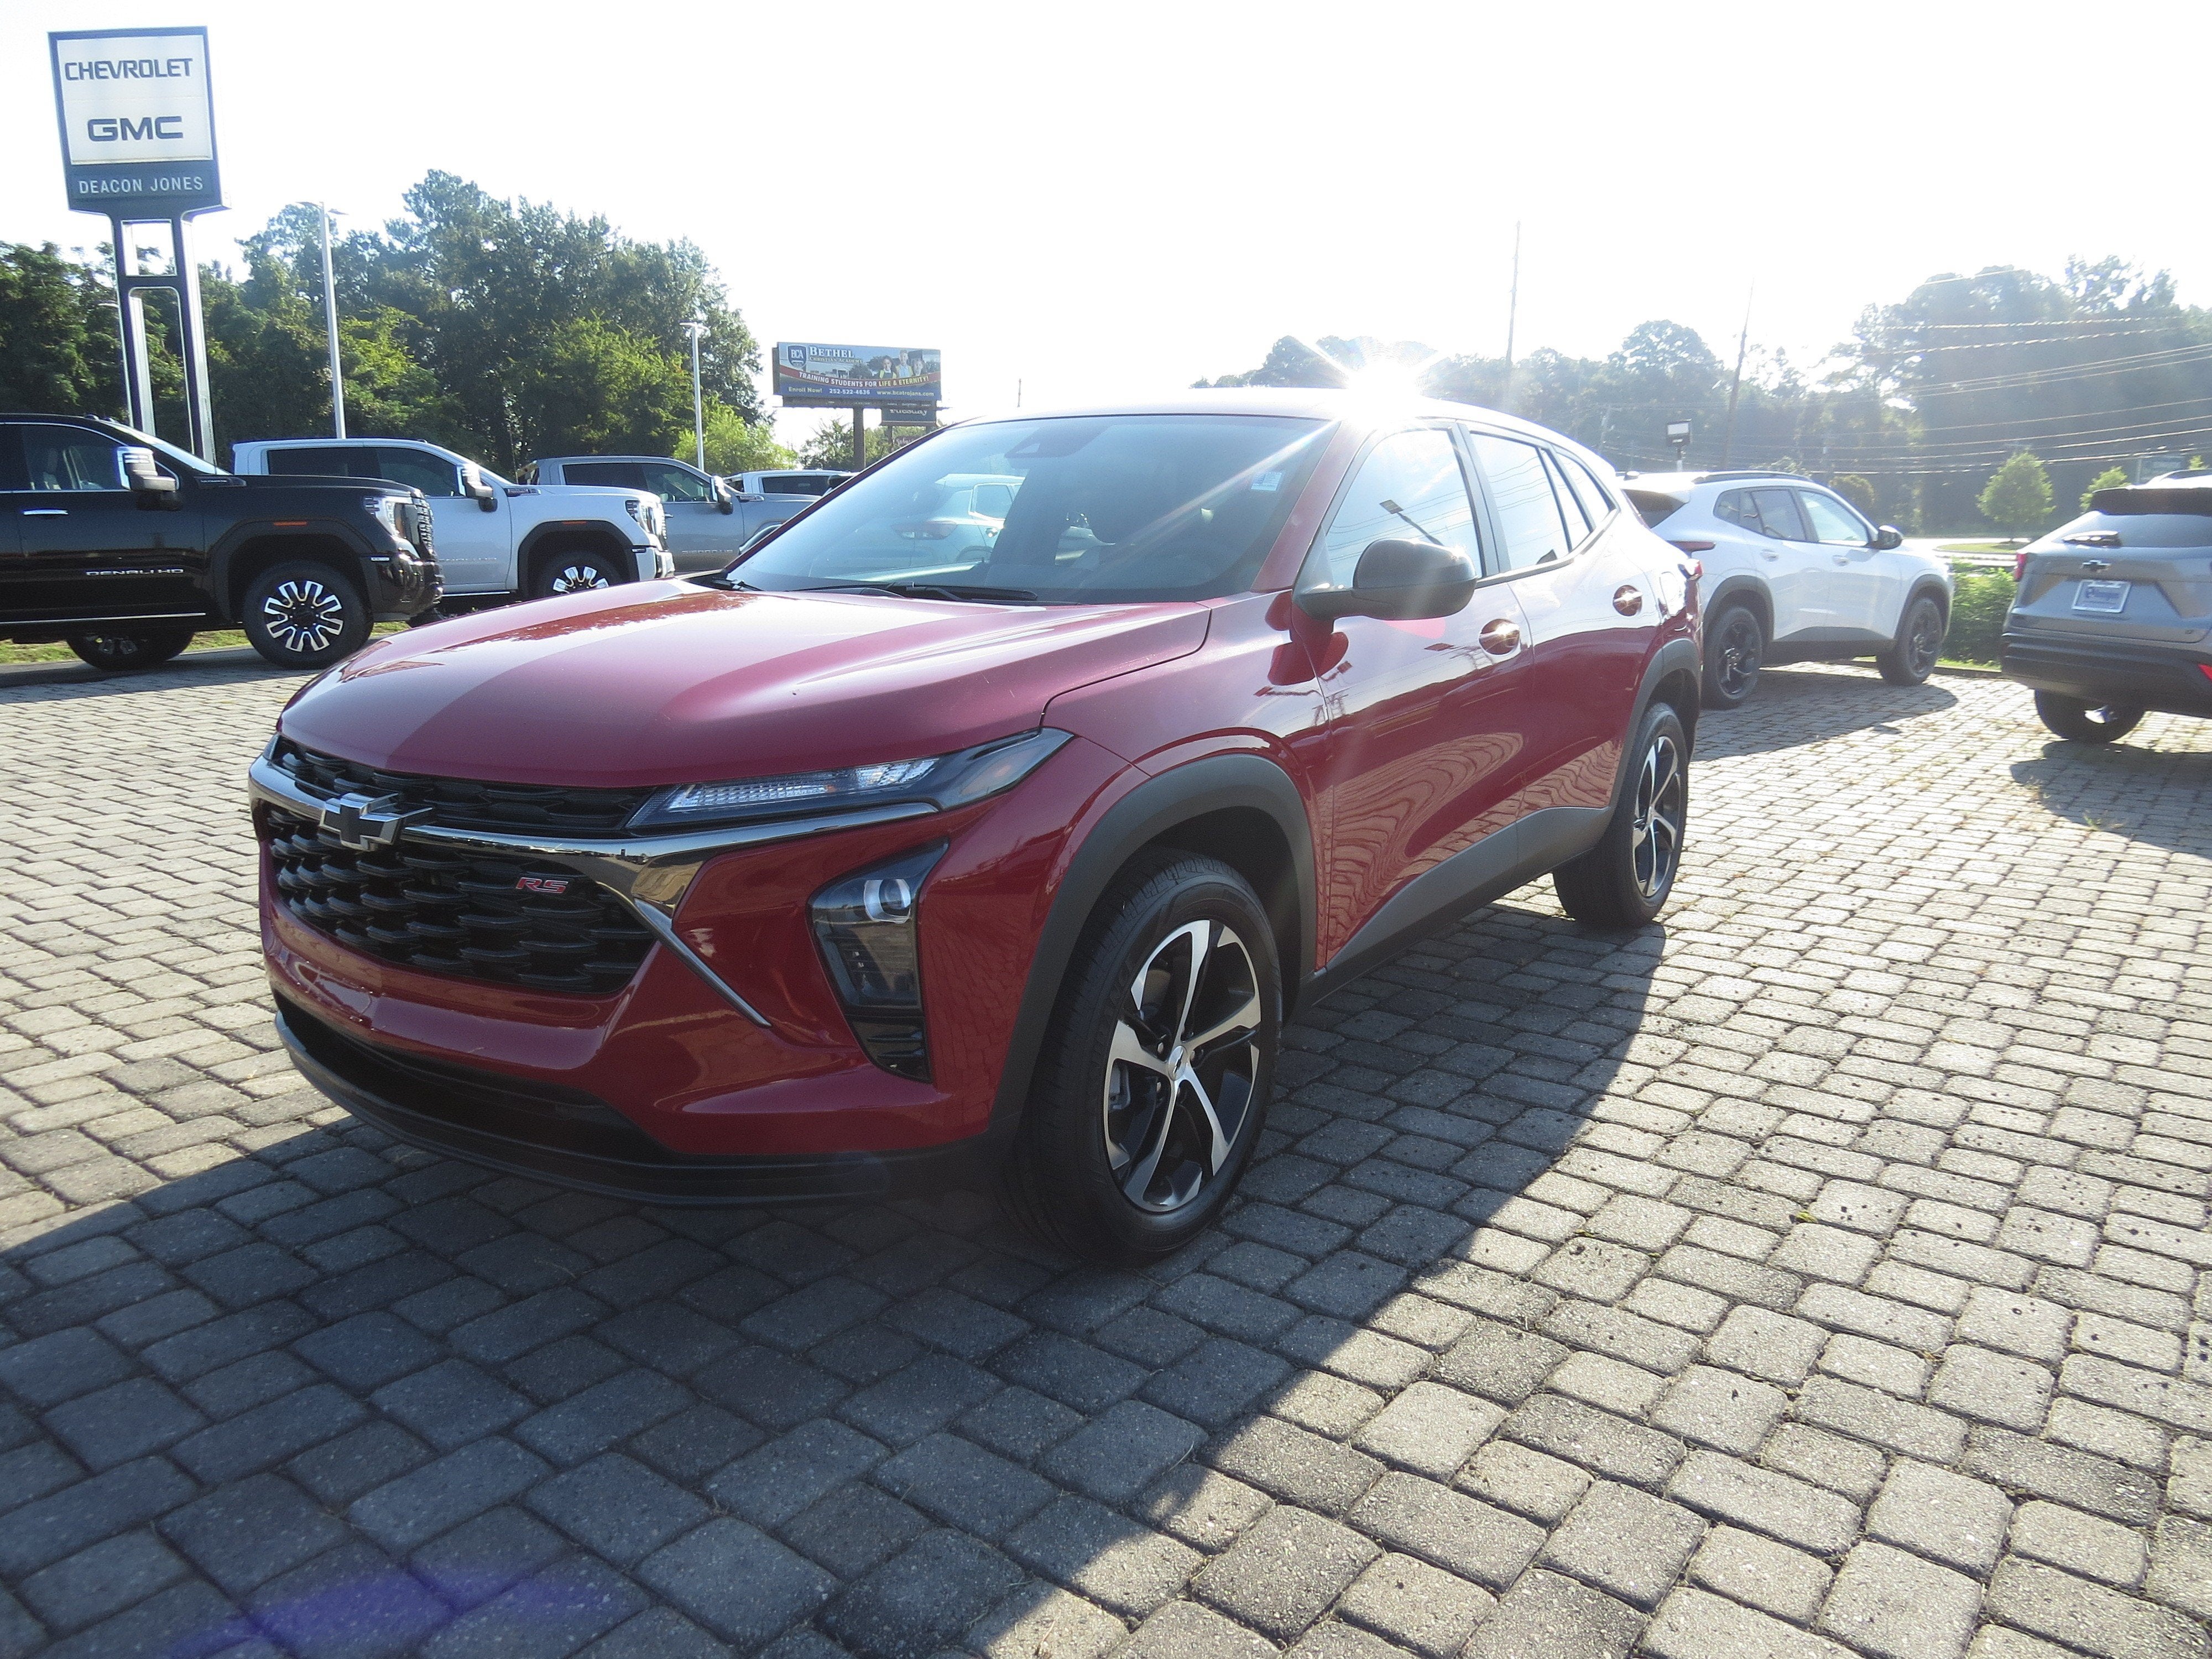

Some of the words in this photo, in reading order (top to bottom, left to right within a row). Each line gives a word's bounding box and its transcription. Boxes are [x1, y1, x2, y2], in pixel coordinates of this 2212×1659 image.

[65, 58, 193, 81] CHEVROLET
[87, 116, 184, 142] GMC
[79, 179, 143, 194] DEACON
[150, 176, 204, 192] JONES
[791, 349, 804, 359] BCA
[809, 346, 854, 358] BETHEL
[799, 371, 829, 383] TRAINING
[831, 378, 863, 387] STUDENTS
[899, 375, 929, 385] ETERNITY!
[515, 877, 568, 894] RS
